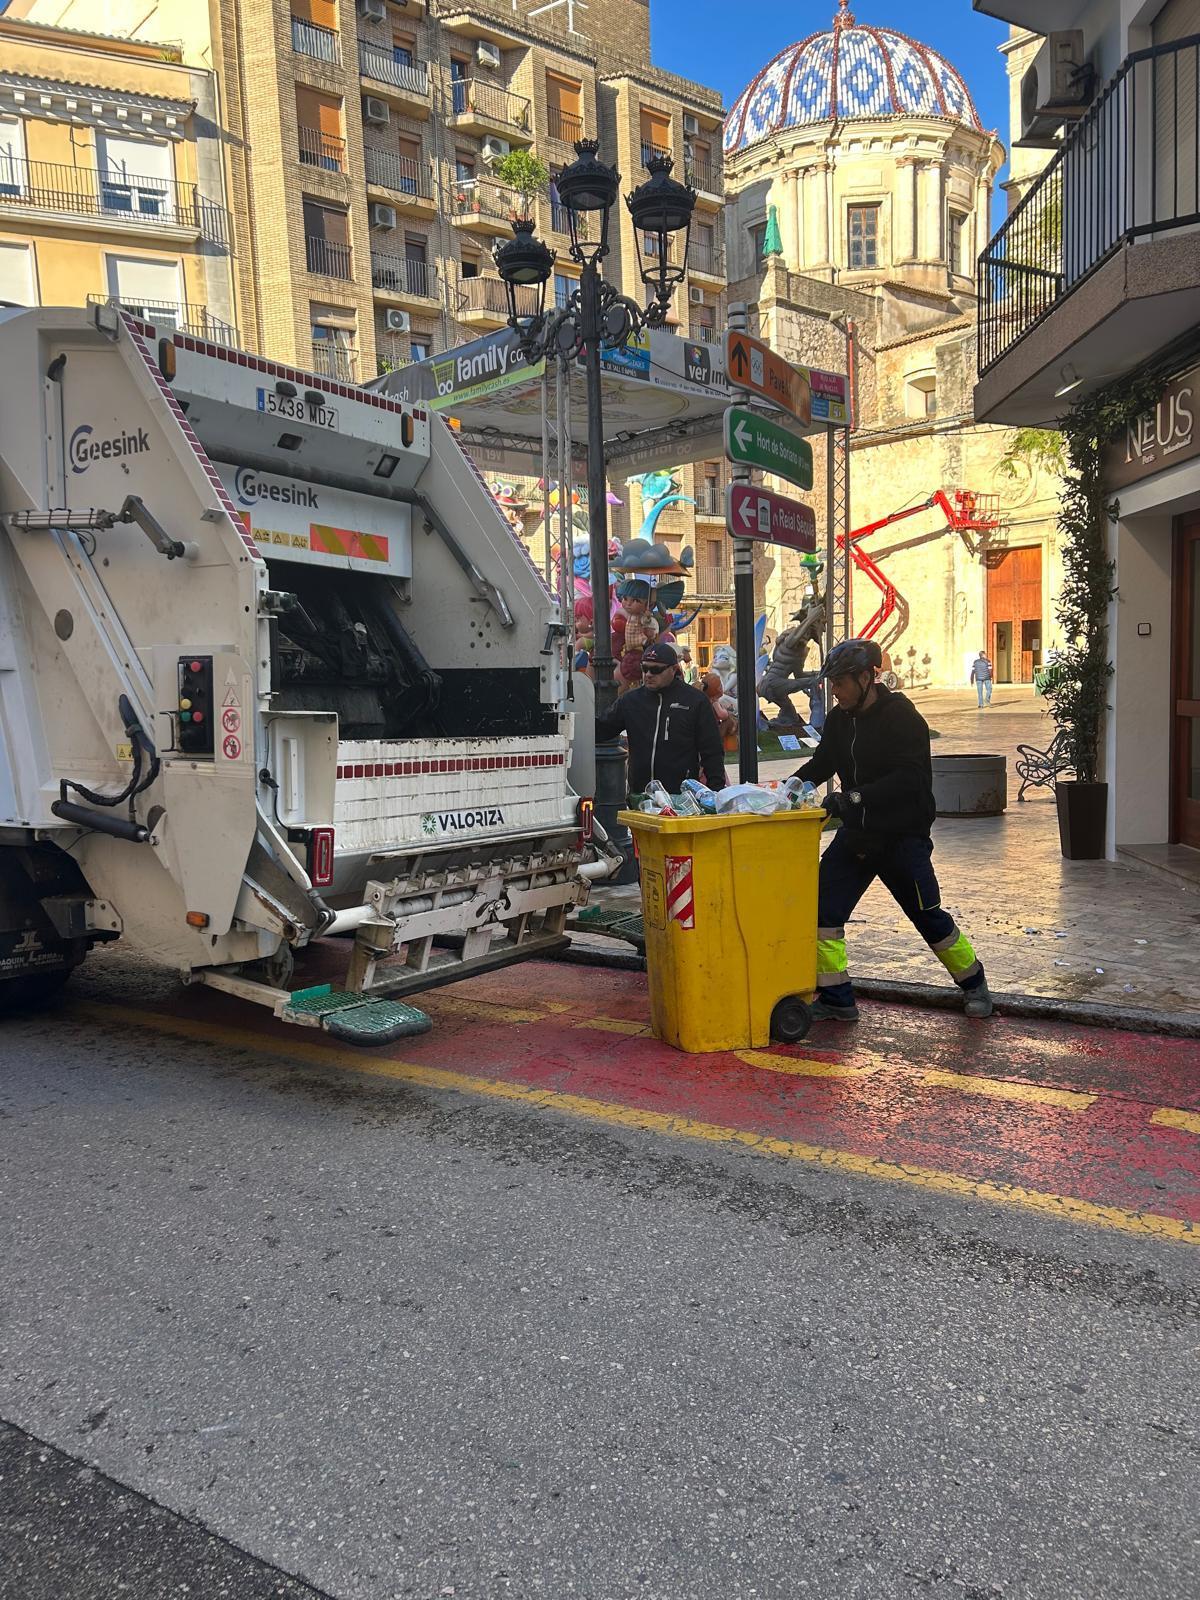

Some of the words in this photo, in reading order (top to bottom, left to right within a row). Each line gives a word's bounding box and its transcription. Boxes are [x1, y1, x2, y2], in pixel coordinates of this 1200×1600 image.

[457, 344, 509, 383] family
[688, 364, 708, 381] ver
[268, 393, 305, 420] 5438
[309, 405, 335, 428] MDZ
[76, 427, 151, 462] Geesink
[756, 431, 771, 454] Hort
[771, 440, 780, 456] de
[242, 474, 319, 509] Geesink
[438, 809, 505, 831] VALORIZA
